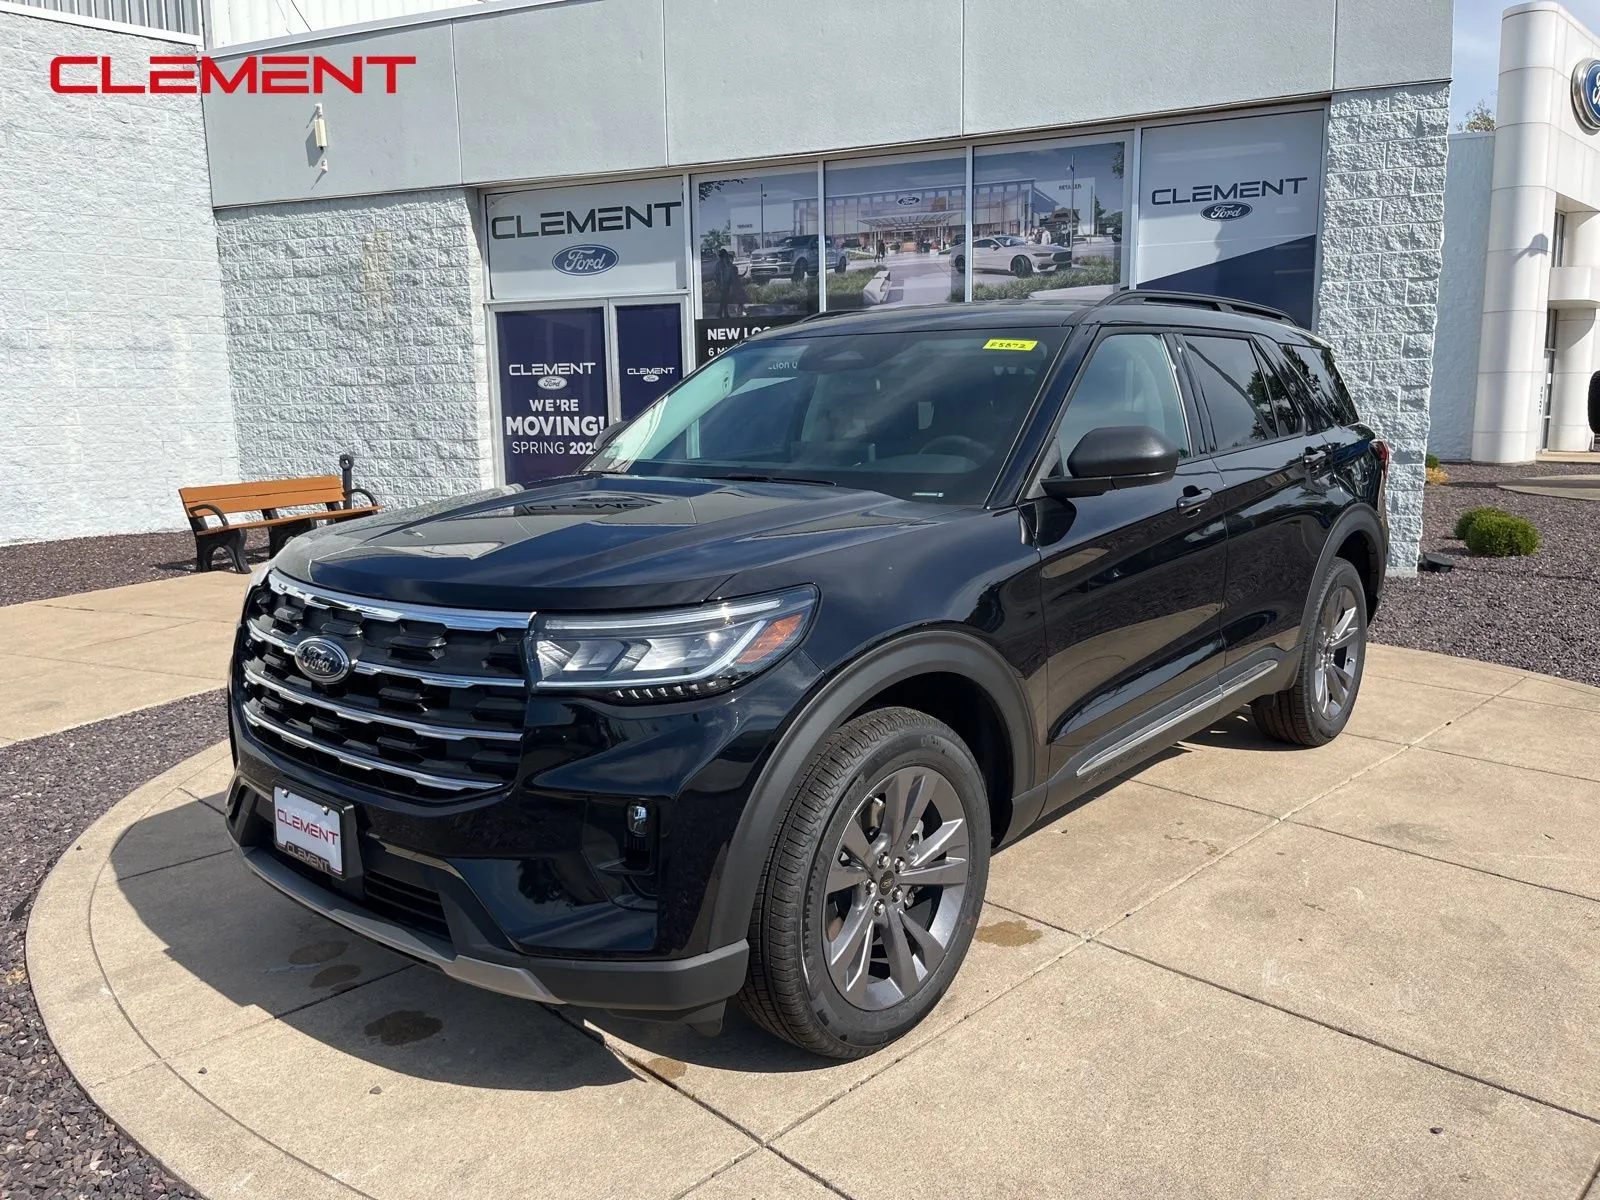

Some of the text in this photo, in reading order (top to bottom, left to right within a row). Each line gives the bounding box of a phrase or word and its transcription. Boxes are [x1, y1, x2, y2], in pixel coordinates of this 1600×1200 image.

[1152, 177, 1308, 206] CLEMENT
[1210, 204, 1242, 218] Ford
[491, 201, 682, 240] CLEMENT
[564, 249, 607, 271] Ford
[707, 327, 741, 341] NEW
[708, 347, 715, 357] 6
[509, 362, 597, 376] CLEMENT
[627, 367, 675, 375] CLEMENT
[529, 399, 579, 412] WE'RE
[505, 415, 605, 436] MOVING!
[512, 441, 597, 455] SPRING 202
[277, 808, 339, 845] CLEMENT
[286, 843, 329, 872] CLEMENT
